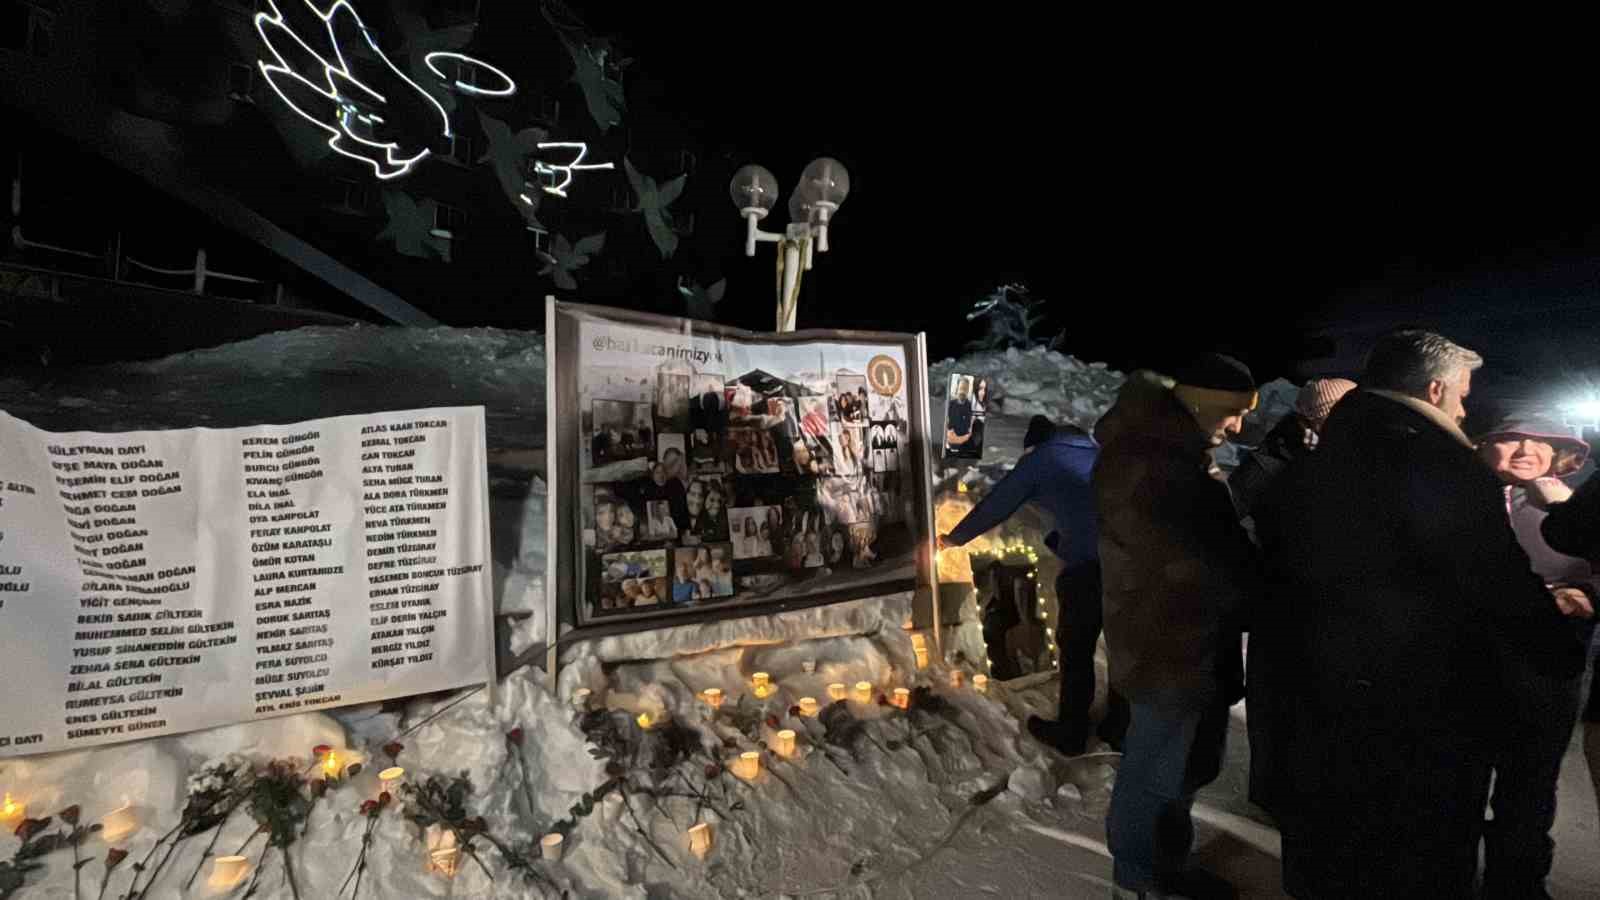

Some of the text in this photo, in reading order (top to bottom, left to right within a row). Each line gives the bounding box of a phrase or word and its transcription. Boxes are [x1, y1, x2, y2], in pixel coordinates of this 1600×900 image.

[361, 425, 388, 434] ATLAS
[415, 420, 447, 430] TOKCAN
[242, 431, 320, 446] KEREM GÜNGÖR
[361, 435, 426, 448] KEMAL TOKCAN
[243, 445, 315, 460] PELİN GÜNGÖR
[361, 449, 415, 461] CAN TOKCAN
[84, 461, 117, 470] MAYA
[121, 459, 164, 470] DOĞAN
[245, 457, 320, 473] BURCU GÜNGÖR
[362, 463, 413, 474] ALYA TURAN
[110, 475, 135, 485] ELİF
[140, 472, 180, 482] DOĞAN
[285, 470, 323, 484] GÜNGÖR
[415, 474, 443, 483] TURAN
[111, 490, 138, 498] CEM
[142, 485, 182, 498] DOĞAN
[248, 490, 266, 498] ELA
[364, 492, 381, 501] ALA
[409, 488, 448, 498] TÜRKMEN
[94, 504, 136, 513] DOĞAN
[248, 502, 271, 511] DİLA
[391, 503, 405, 512] ATA
[406, 502, 446, 511] TÜRKMEN
[94, 517, 136, 528] DOĞAN
[390, 516, 430, 527] TÜRKMEN
[71, 529, 148, 543] YGU DOĞAN
[396, 530, 437, 540] TÜRKMEN
[102, 543, 144, 556] DOĞAN
[252, 541, 280, 553] ÖZÜM
[367, 546, 395, 557] DEMİR
[106, 558, 146, 570] DOĞAN
[368, 561, 395, 571] DEFNE
[158, 566, 196, 580] DOĞAN
[253, 571, 286, 582] LAURA
[255, 583, 316, 596] ALP MERCAN
[369, 588, 399, 598] ERHAN
[255, 596, 312, 611] ESRA NAZİK
[77, 613, 113, 624] BEKİR
[257, 609, 330, 625] DORUK SARITAŞ
[371, 609, 446, 626] ELİF DERİN YALÇIN
[188, 621, 234, 634] GÜLTEKİN
[257, 624, 328, 640] NEHİR SARITAŞ
[371, 626, 435, 640] ATAKAN YALÇIN
[73, 648, 112, 657] YUSUF
[189, 636, 237, 649] GÜLTEKİN
[256, 638, 334, 654] YILMAZ SARITAŞ
[405, 640, 430, 650] YILDIZ
[70, 664, 110, 674] ZEHRA
[149, 655, 200, 667] GÜLTEKİN
[256, 660, 282, 670] PERA
[372, 653, 433, 669] KÜRŞAT YILDIZ
[68, 674, 162, 692] BİLAL GÜLTEKİN
[66, 688, 183, 709] RUMEYSA GÜLTEKİN
[256, 689, 293, 702] ŞEVVAL
[66, 707, 157, 725] ENES GÜLTEKİN
[67, 725, 124, 739] SÜMEYYE
